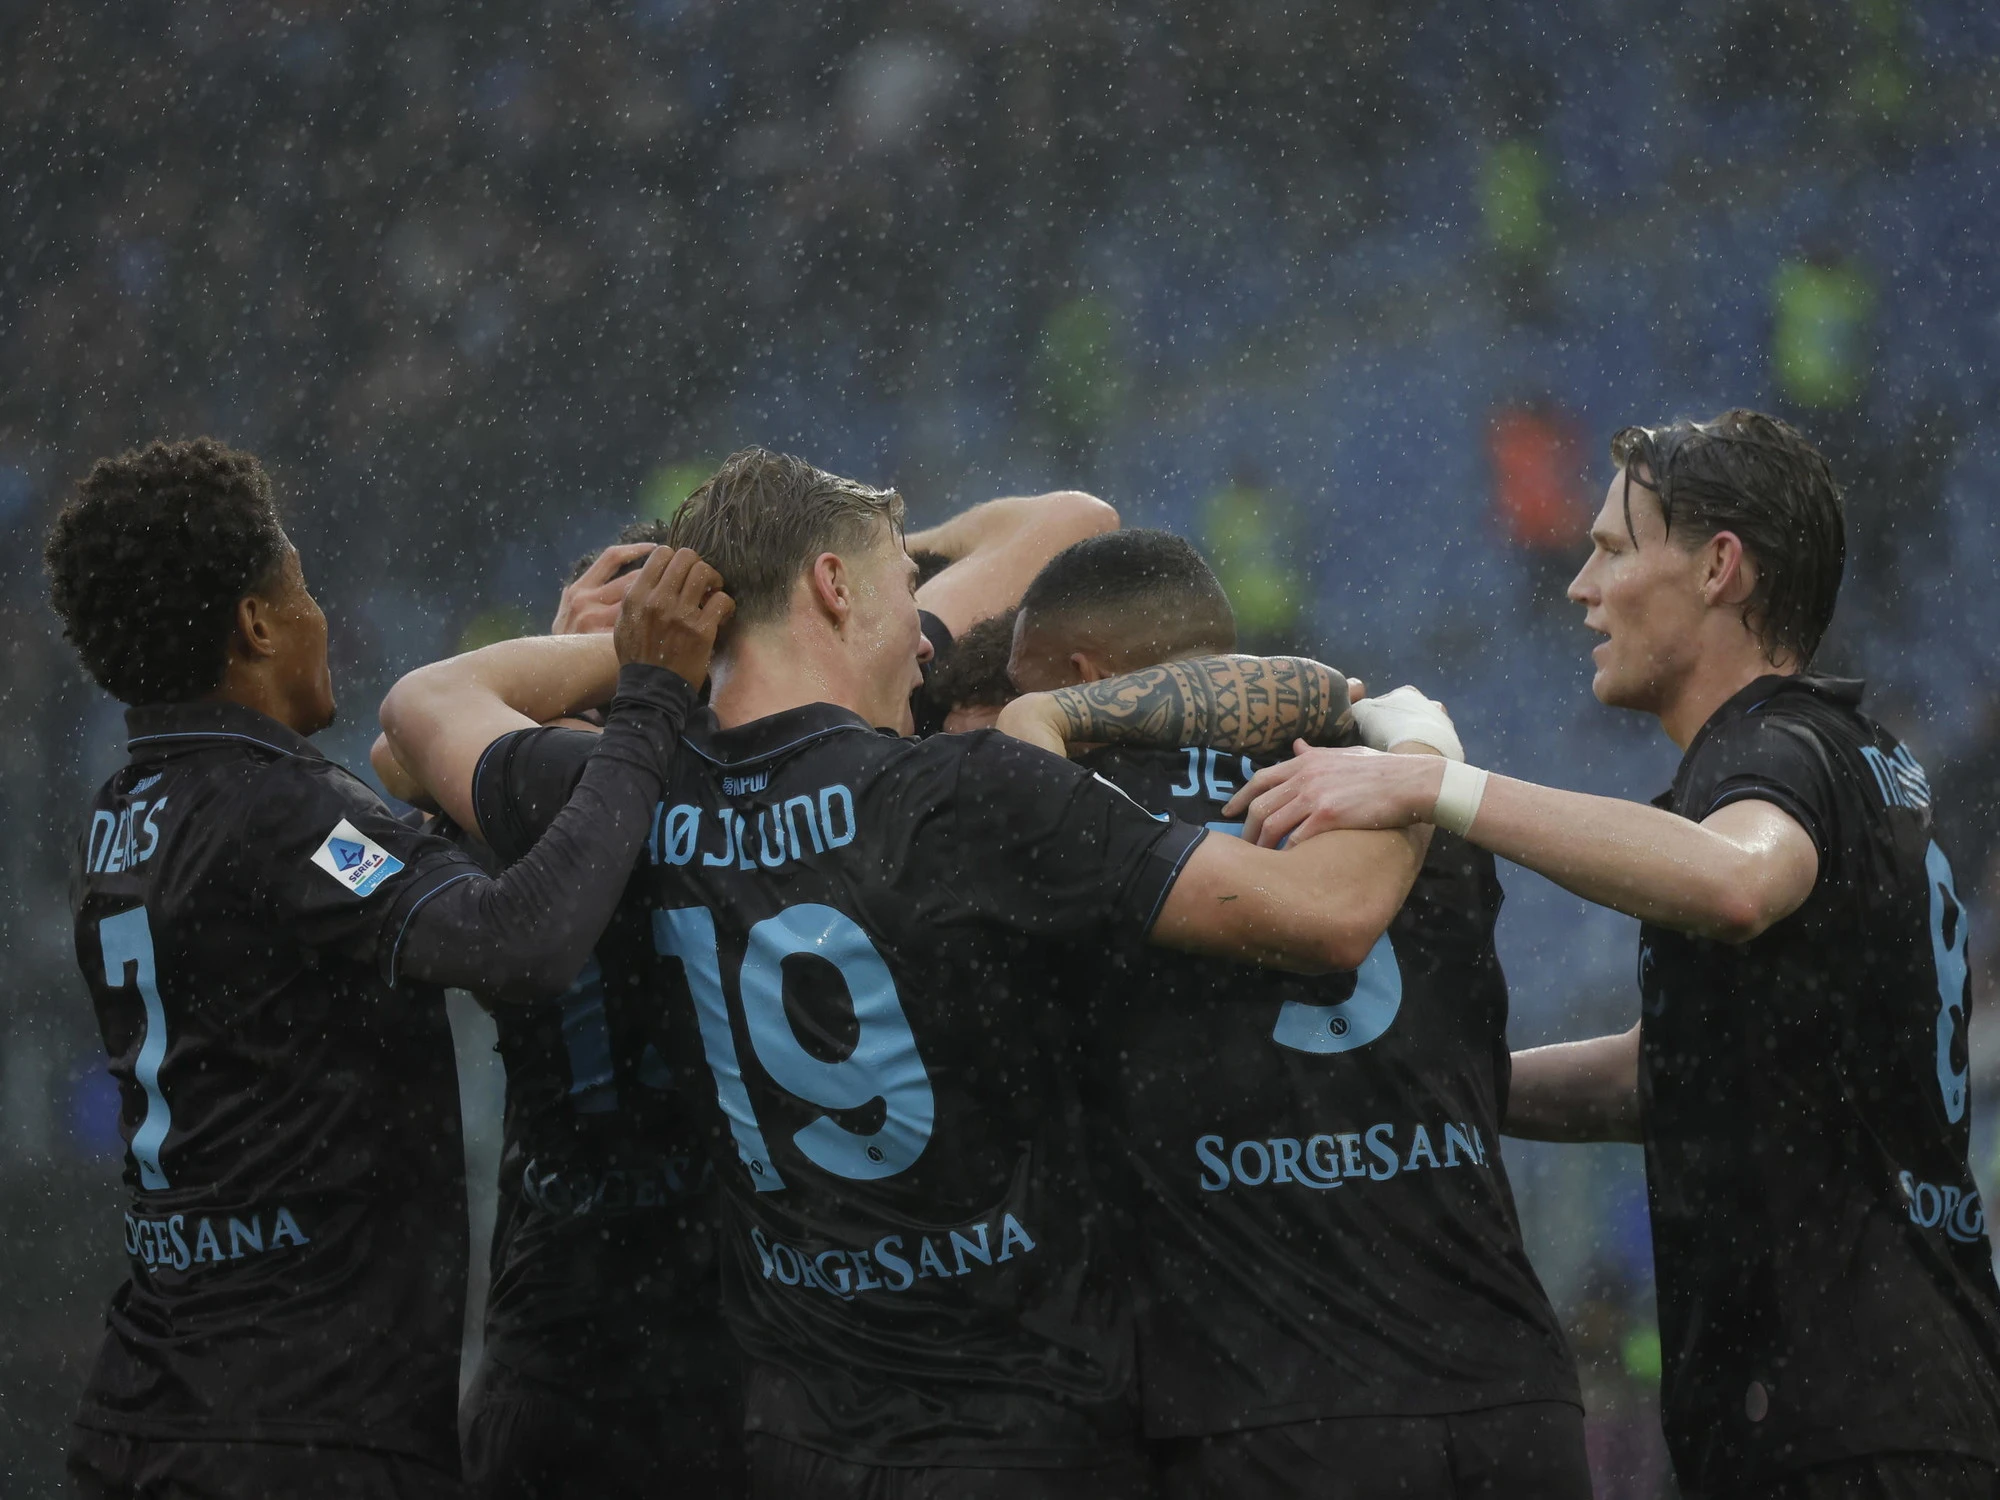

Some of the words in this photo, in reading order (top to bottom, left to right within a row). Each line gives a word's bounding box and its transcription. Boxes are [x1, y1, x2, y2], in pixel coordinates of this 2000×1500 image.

[349, 860, 373, 883] SERIE
[372, 853, 381, 862] A
[1925, 838, 1968, 1125] 8
[99, 905, 172, 1191] 7
[651, 902, 935, 1192] 19
[1195, 1122, 1490, 1192] SORGESANA
[124, 1206, 310, 1273] ORGESANA
[751, 1213, 1036, 1301] SORGESANA
